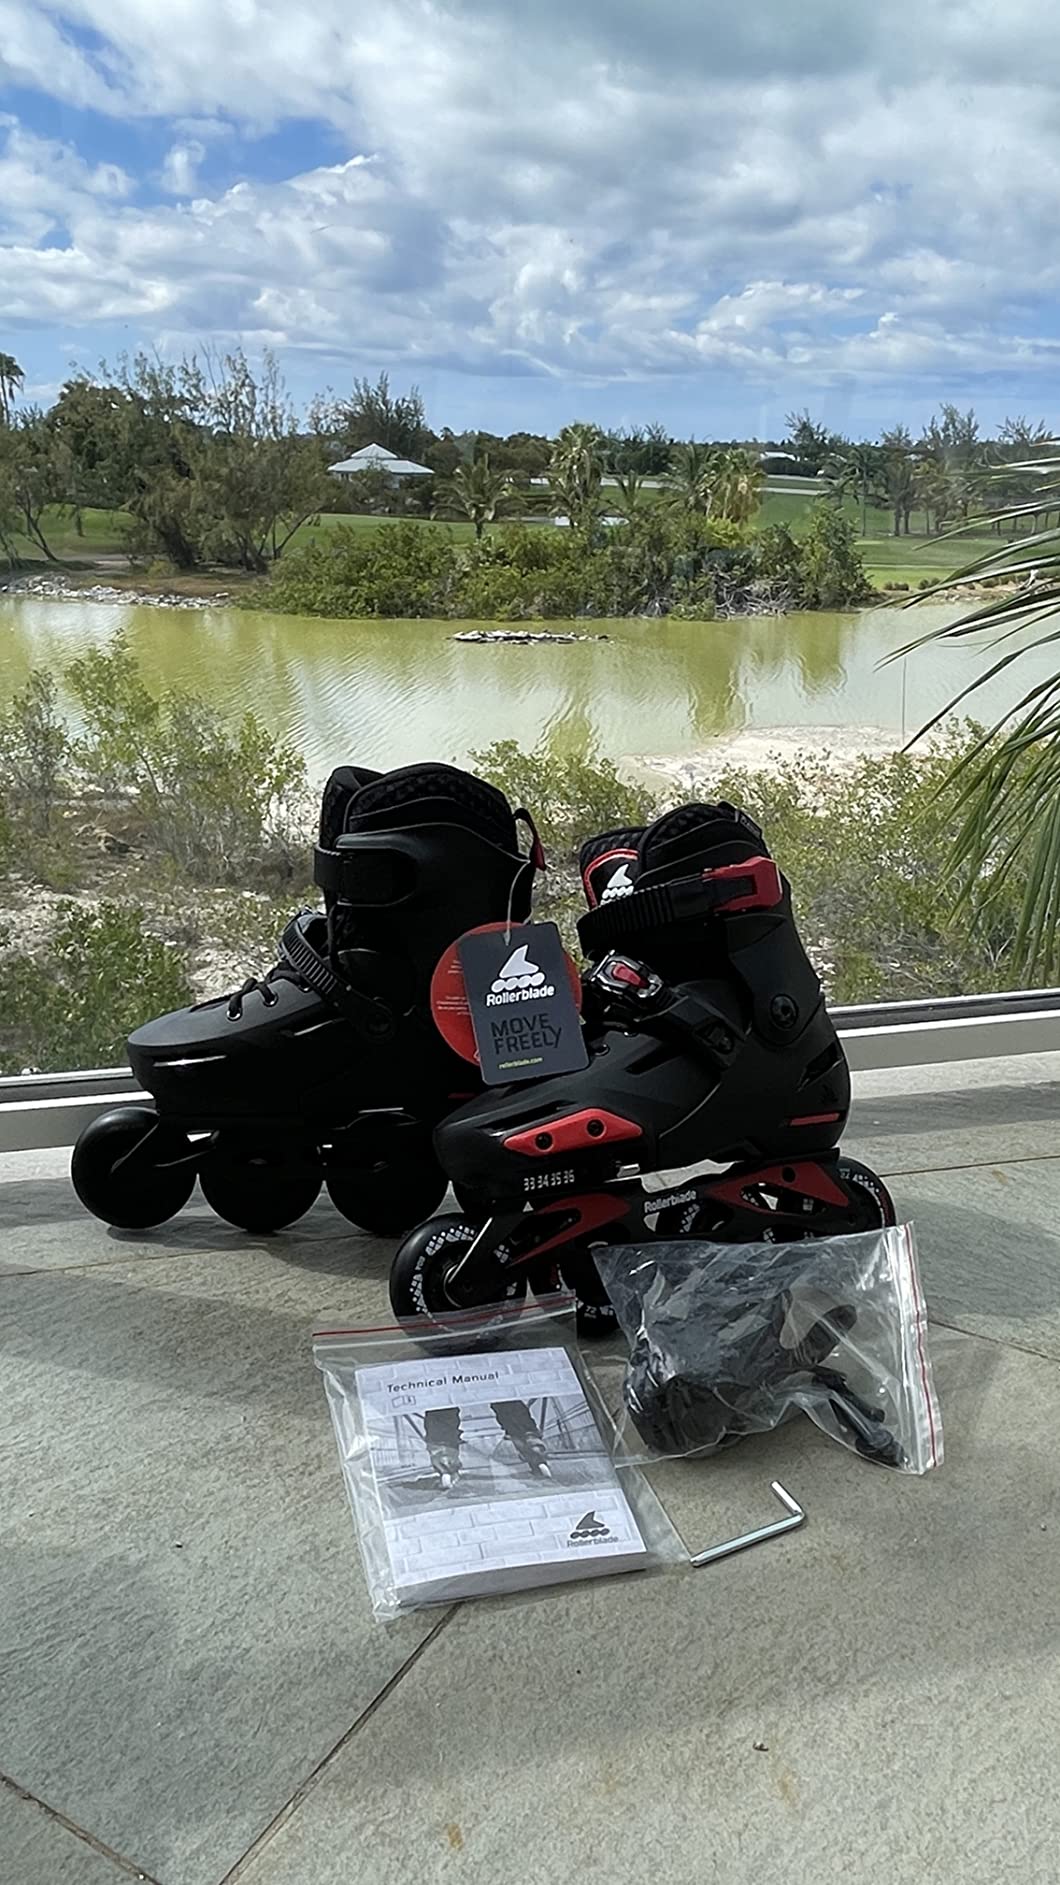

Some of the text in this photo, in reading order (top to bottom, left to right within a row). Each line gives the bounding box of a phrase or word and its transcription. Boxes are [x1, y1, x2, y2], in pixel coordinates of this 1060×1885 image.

[486, 985, 555, 1007] Rollerblade
[491, 1013, 550, 1038] MOVE
[495, 1027, 562, 1055] FREELY
[523, 1177, 535, 1191] 33
[537, 1175, 549, 1189] 34
[550, 1172, 562, 1186] 35
[644, 1190, 697, 1213] Rollerblade
[387, 1371, 499, 1393] Technical Manual
[566, 1536, 619, 1548] Rollerblade
